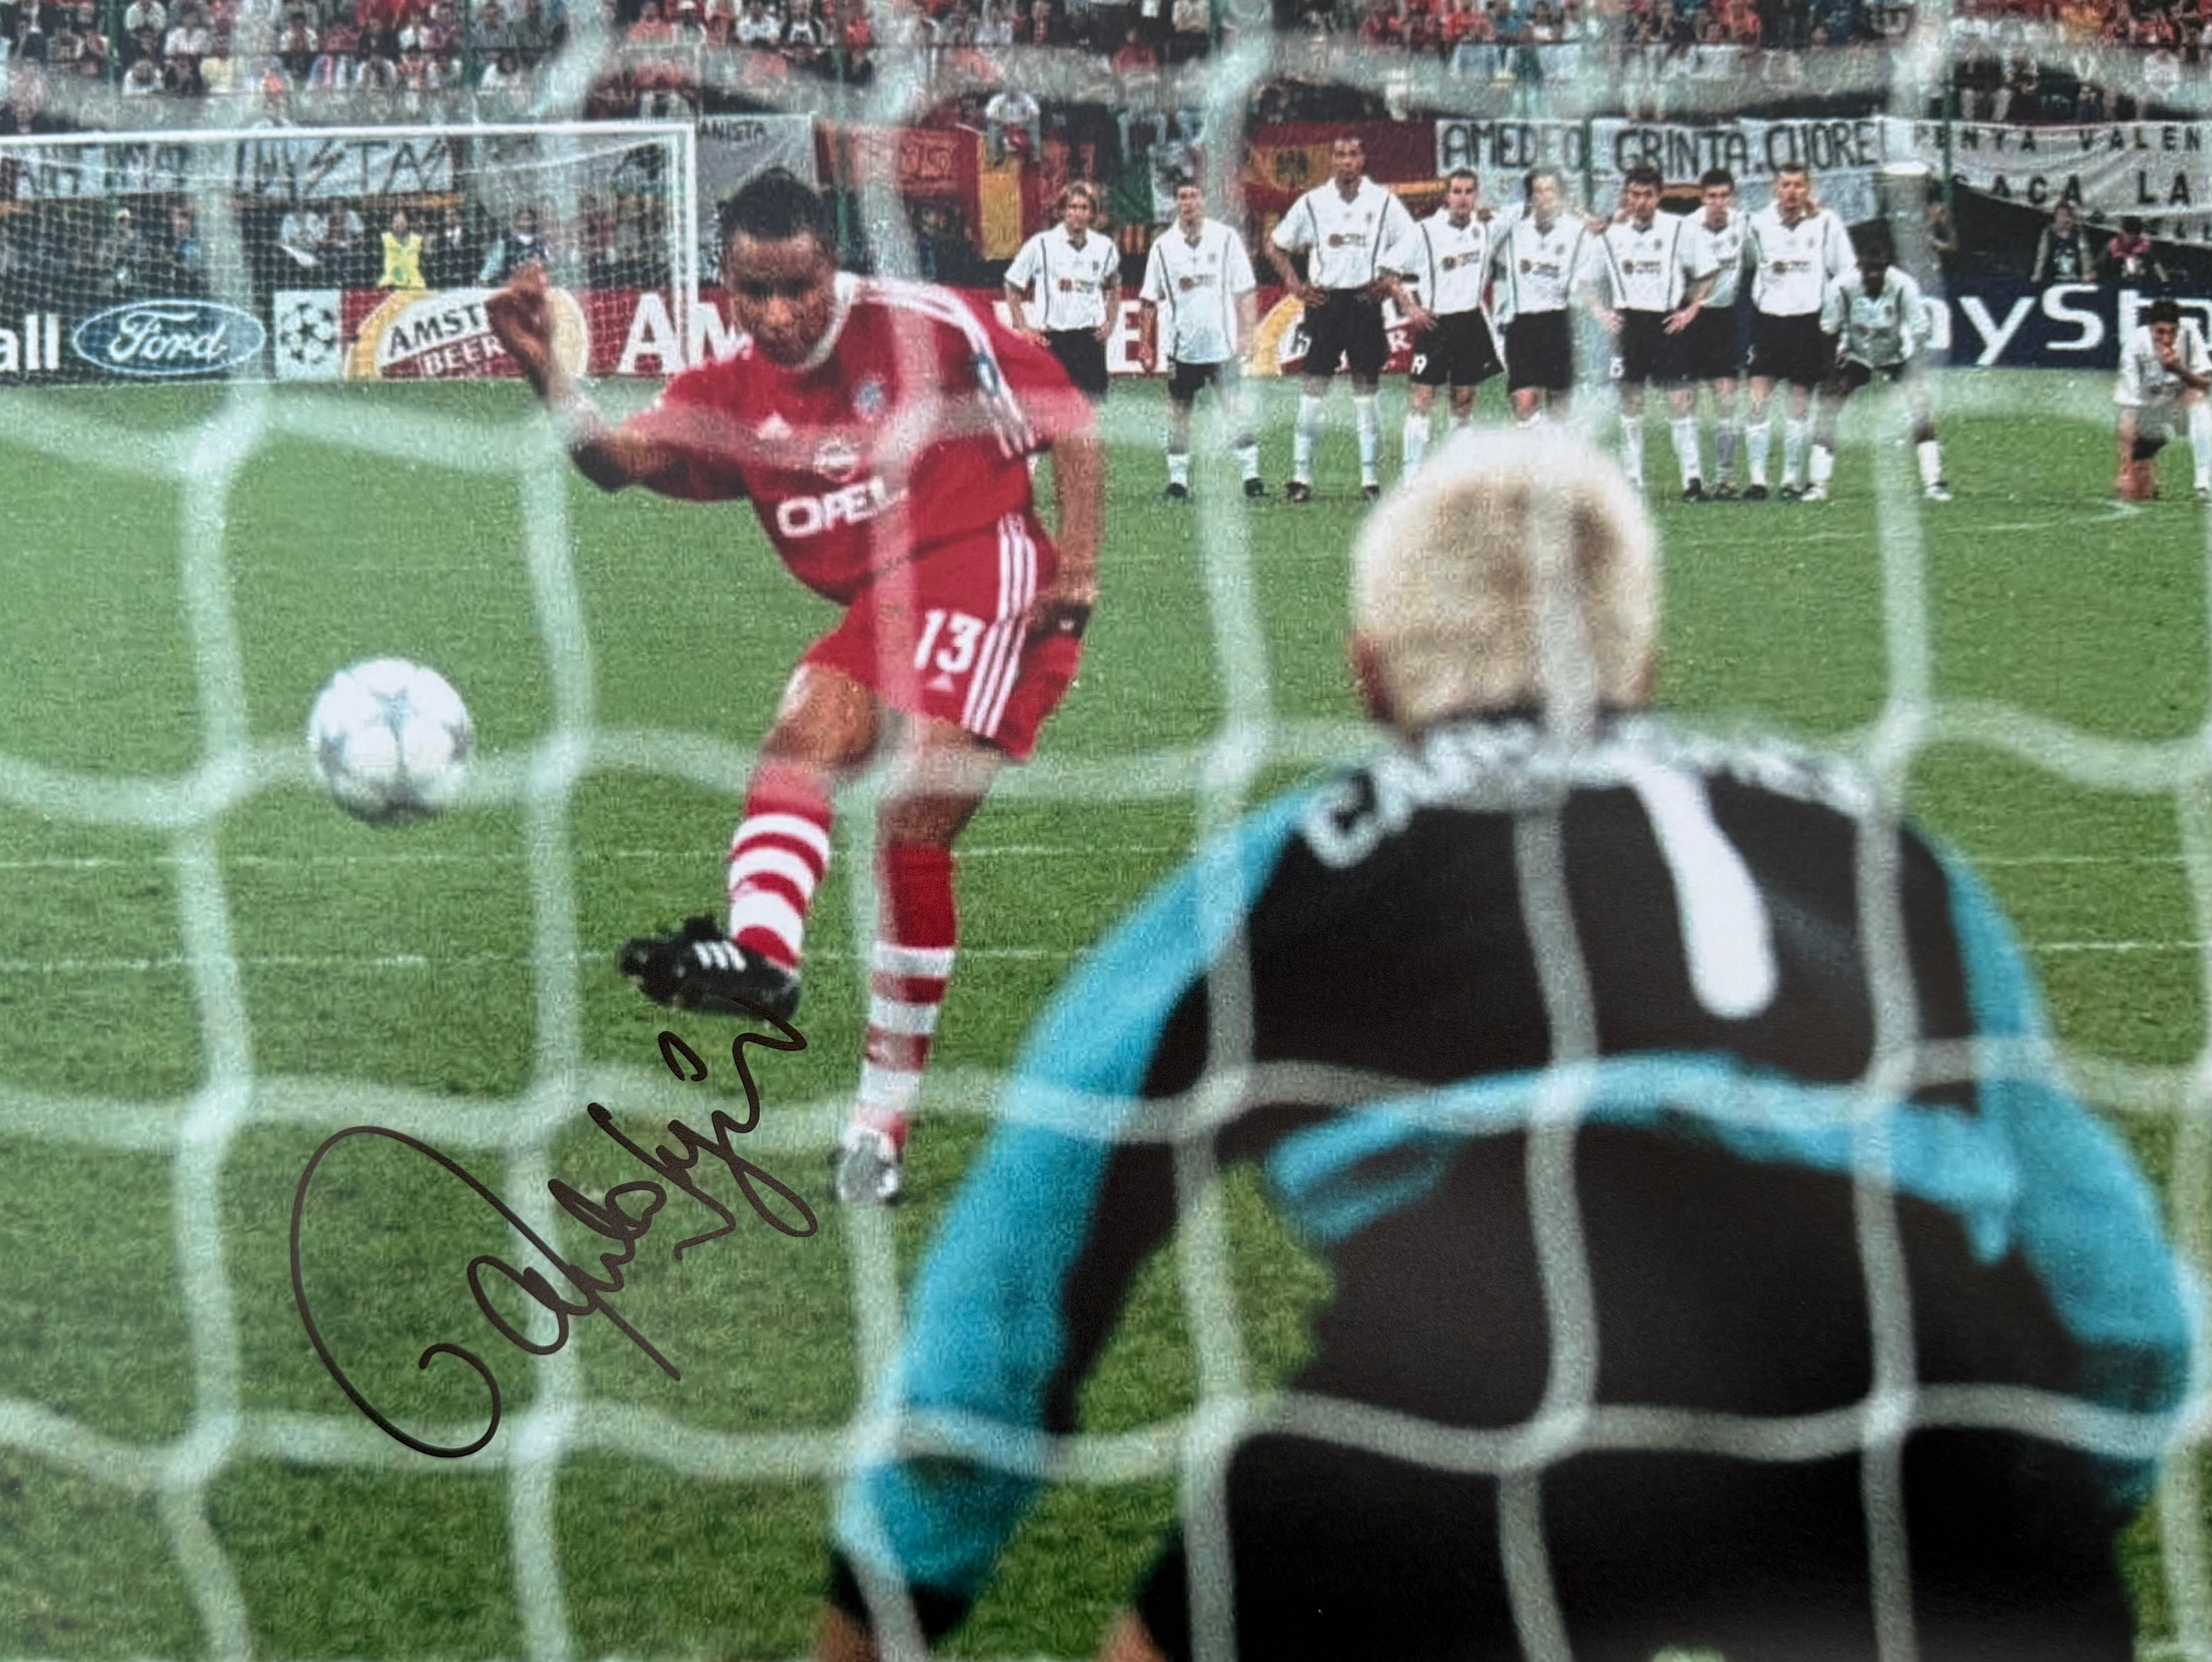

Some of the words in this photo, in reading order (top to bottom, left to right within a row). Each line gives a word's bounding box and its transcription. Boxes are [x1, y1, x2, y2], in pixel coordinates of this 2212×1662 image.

[110, 310, 228, 364] Ford
[387, 303, 484, 357] AMST
[776, 475, 908, 537] OPEL
[914, 608, 986, 674] 13
